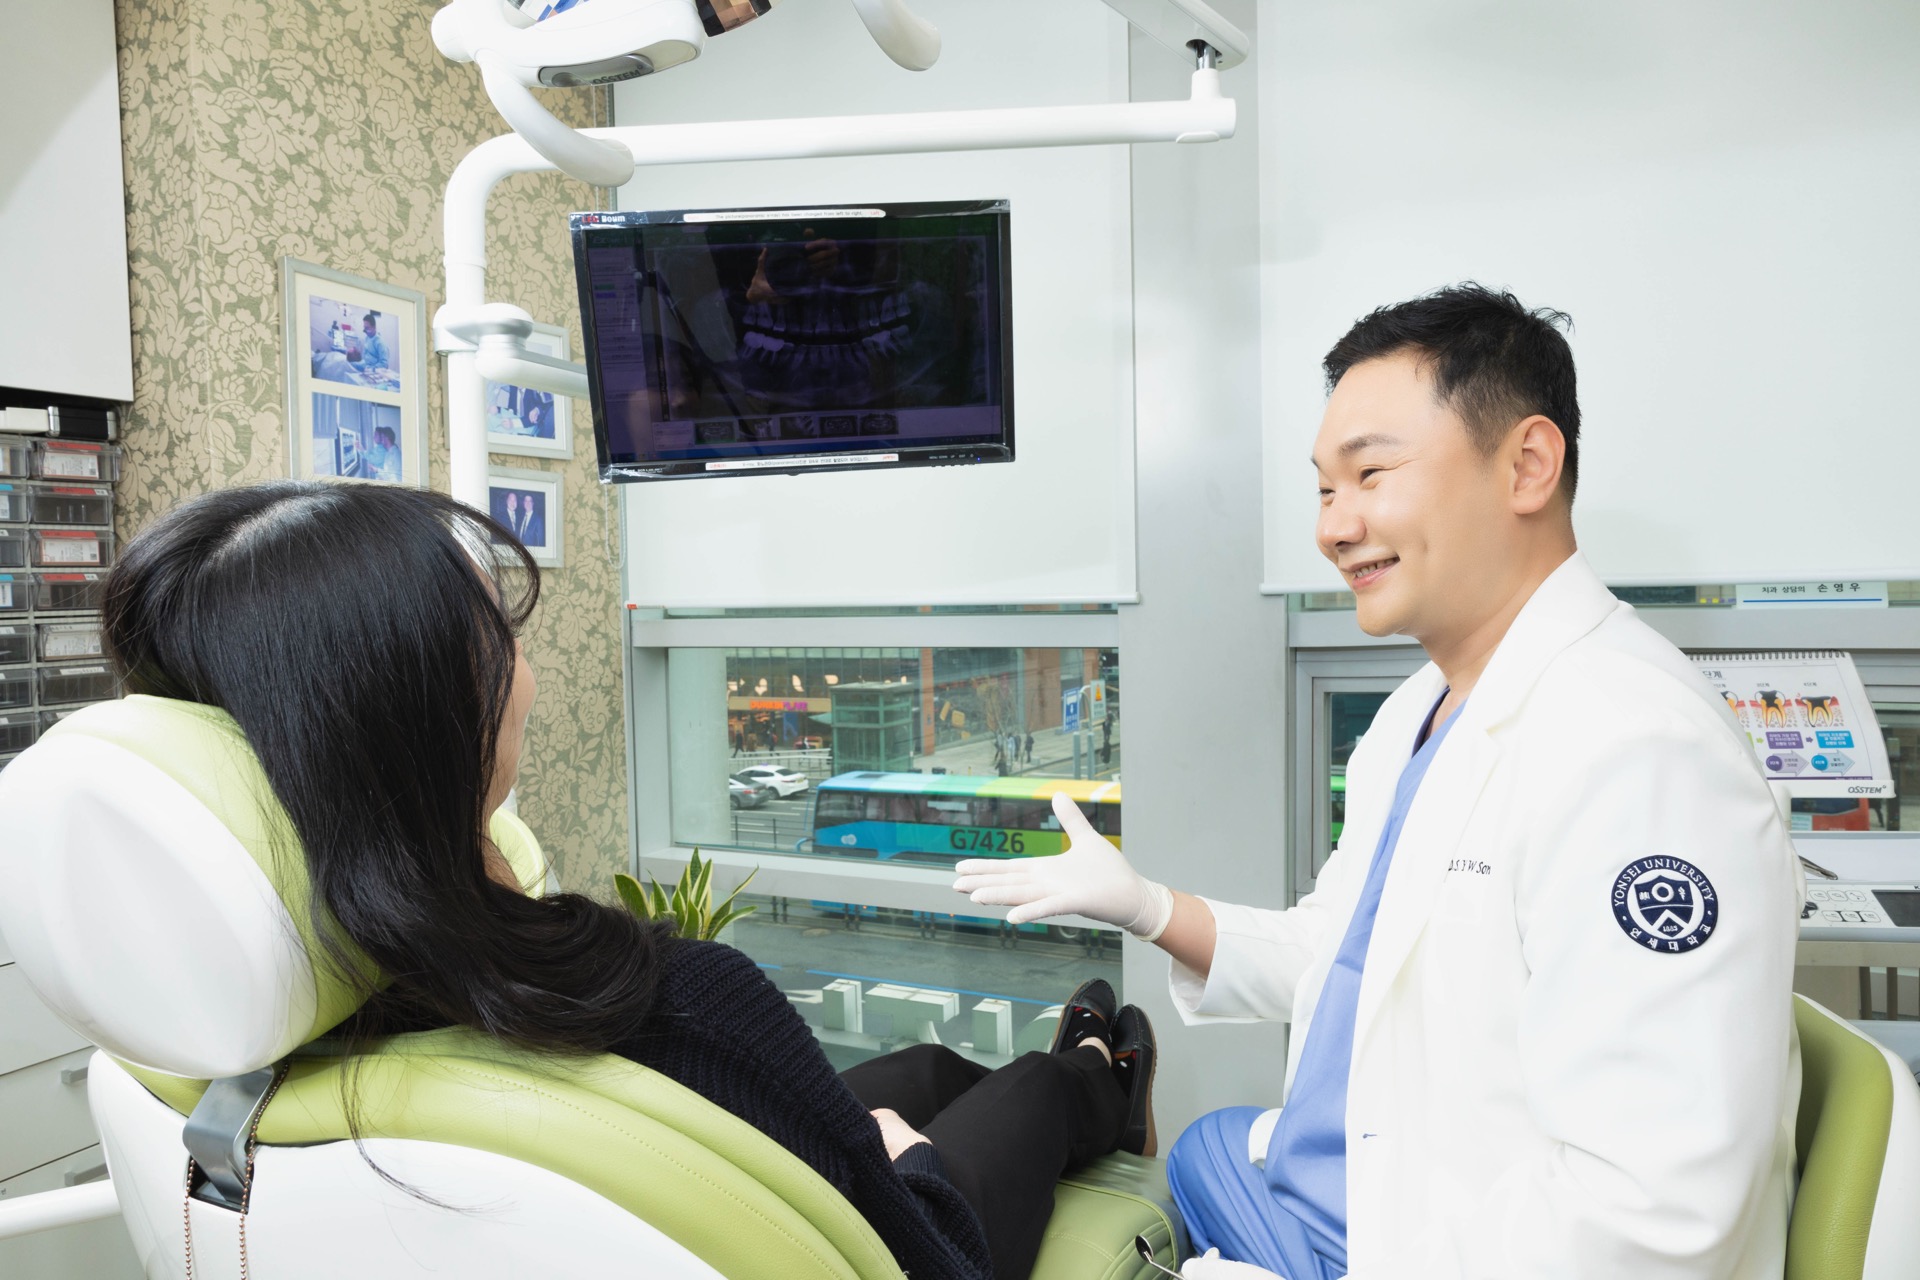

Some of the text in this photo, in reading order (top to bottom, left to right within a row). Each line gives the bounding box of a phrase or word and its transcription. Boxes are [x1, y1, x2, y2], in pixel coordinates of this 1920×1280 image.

[1761, 586, 1778, 594] 치과
[1782, 585, 1806, 594] 상담의
[1847, 786, 1882, 794] OSSTEM
[950, 828, 1025, 854] G7426
[1614, 858, 1714, 907] YONSEI UNIVERSITY
